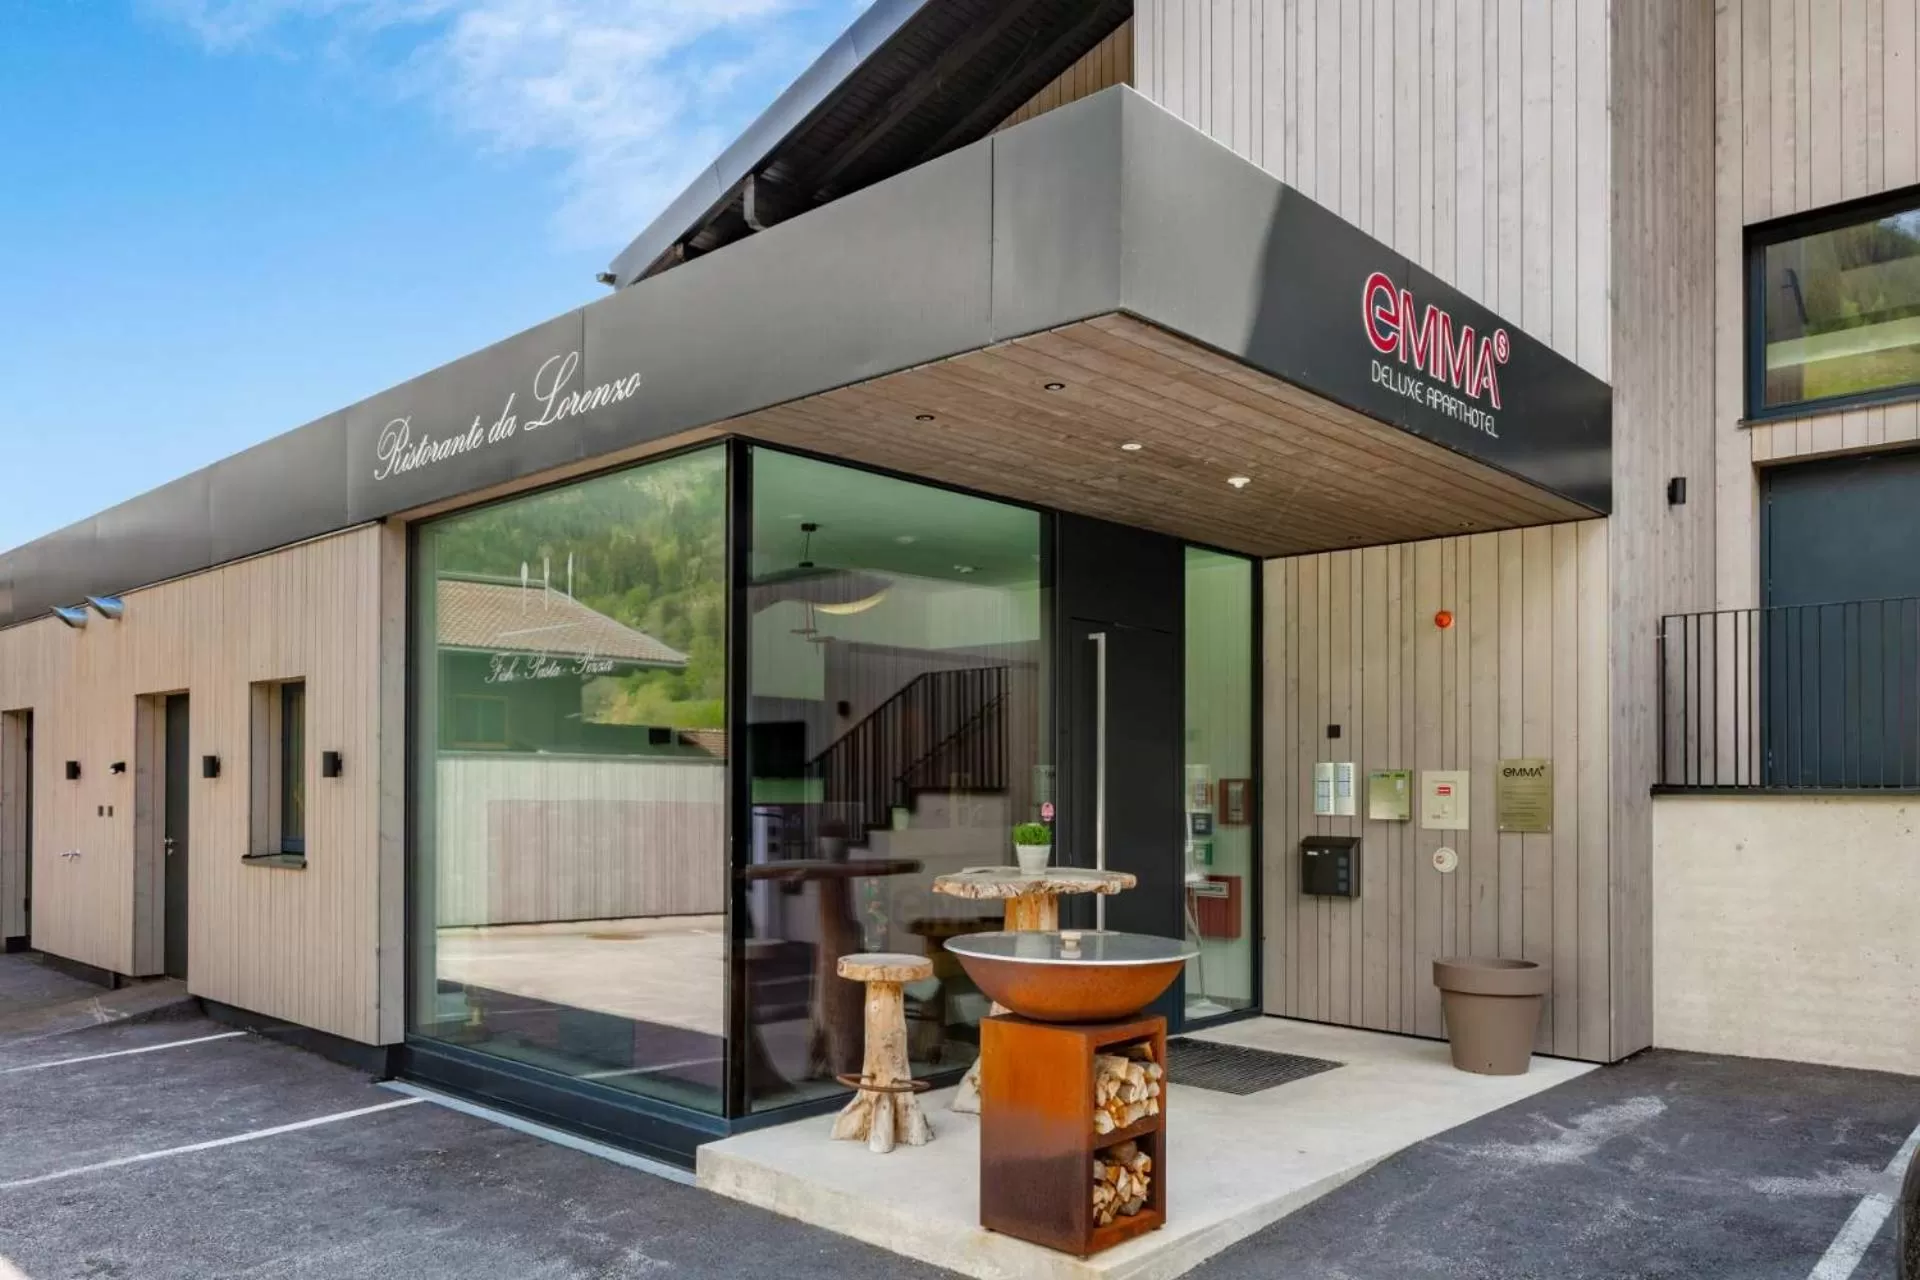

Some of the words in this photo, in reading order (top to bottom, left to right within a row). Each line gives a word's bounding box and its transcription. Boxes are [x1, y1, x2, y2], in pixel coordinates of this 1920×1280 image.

[374, 415, 483, 481] Ristorante
[489, 392, 517, 443] da
[524, 351, 641, 431] Lorenzo
[1371, 360, 1424, 404] DELUXE
[1426, 386, 1500, 438] APARTHOTEL
